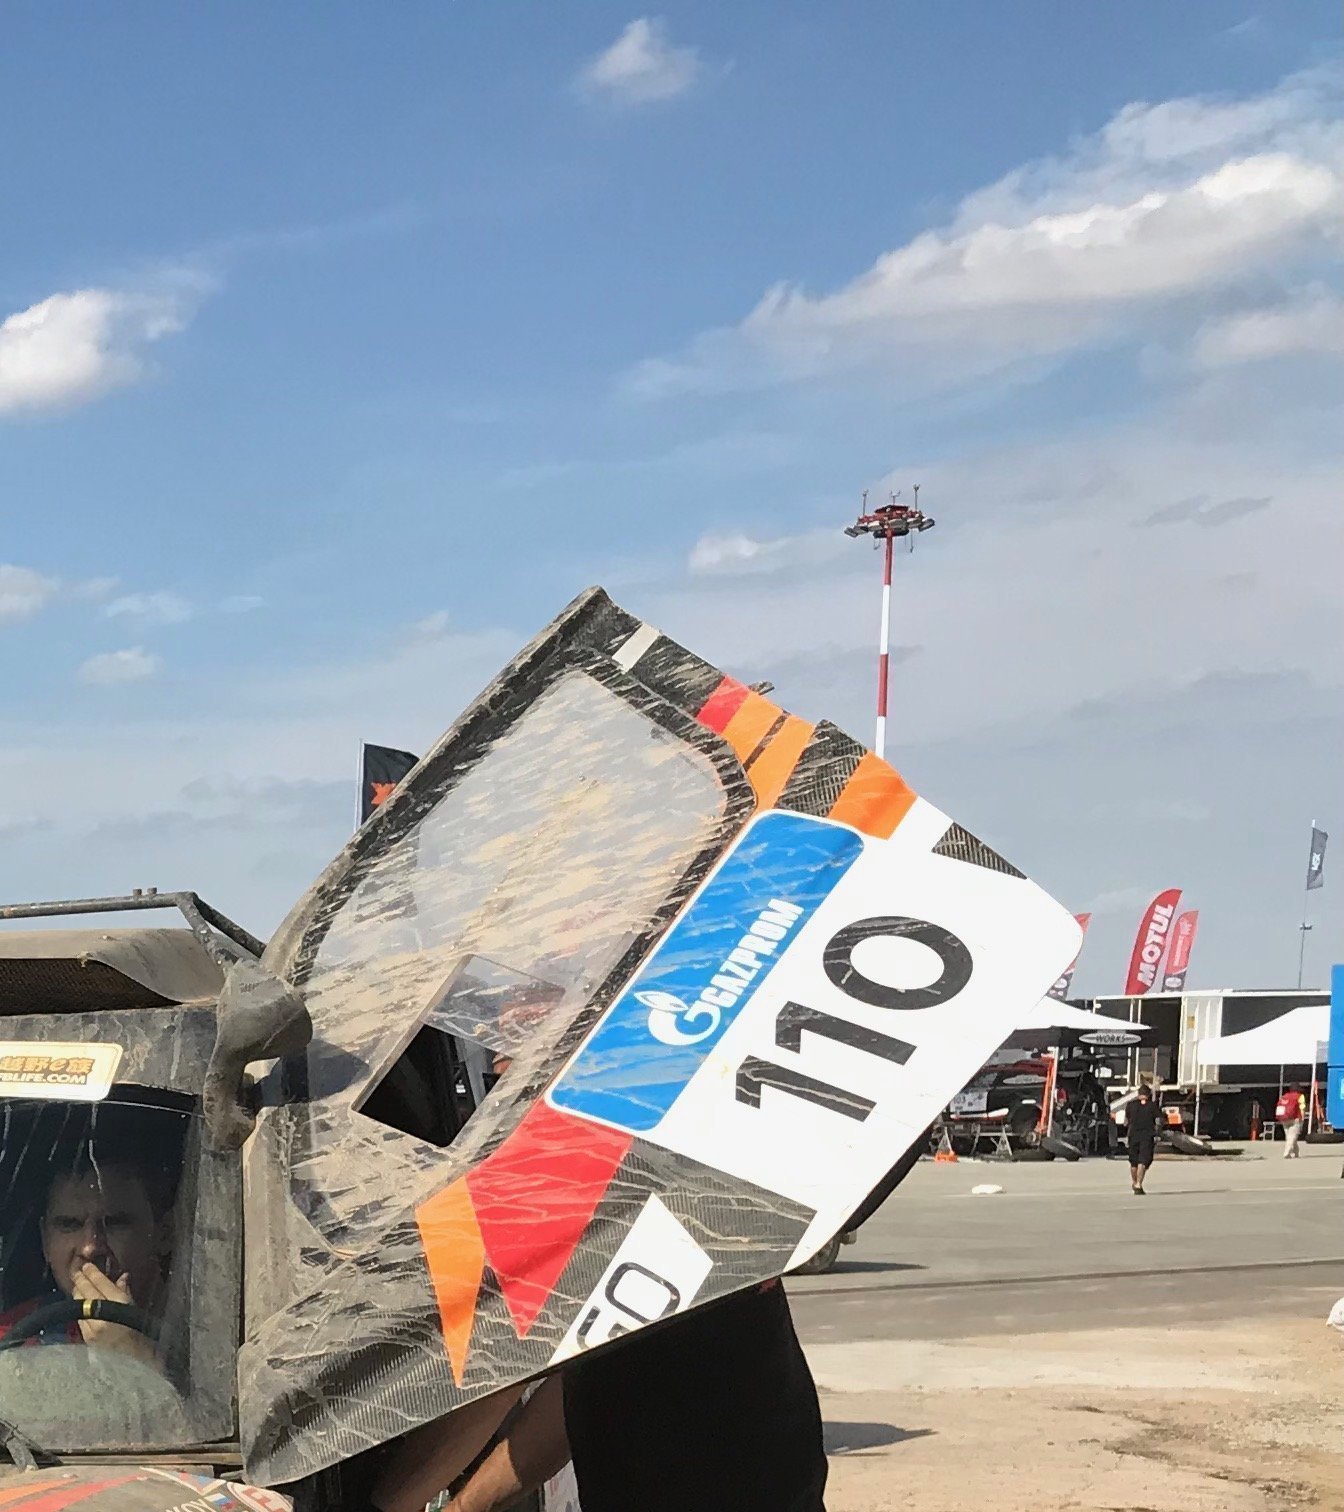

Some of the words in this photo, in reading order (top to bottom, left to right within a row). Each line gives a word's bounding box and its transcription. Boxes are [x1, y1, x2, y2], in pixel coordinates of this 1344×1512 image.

[704, 898, 804, 1015] GAZPROM
[1137, 903, 1173, 987] MOTUL
[735, 915, 974, 1123] 110
